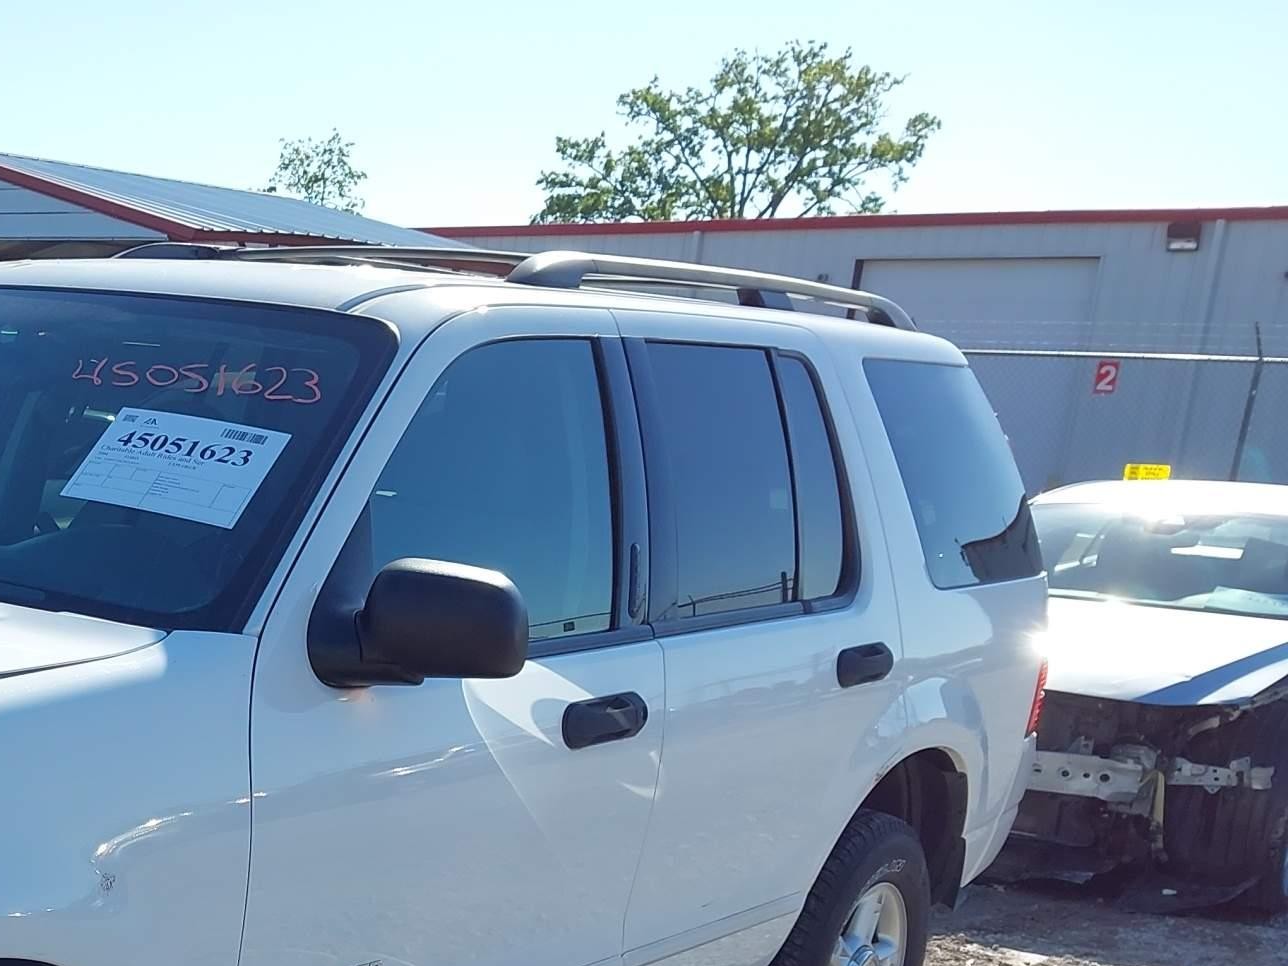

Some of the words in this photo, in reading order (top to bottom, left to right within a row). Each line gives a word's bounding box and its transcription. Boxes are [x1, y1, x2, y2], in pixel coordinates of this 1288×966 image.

[71, 356, 322, 404] 45051623
[1095, 364, 1117, 391] 2
[117, 430, 254, 468] 45051623
